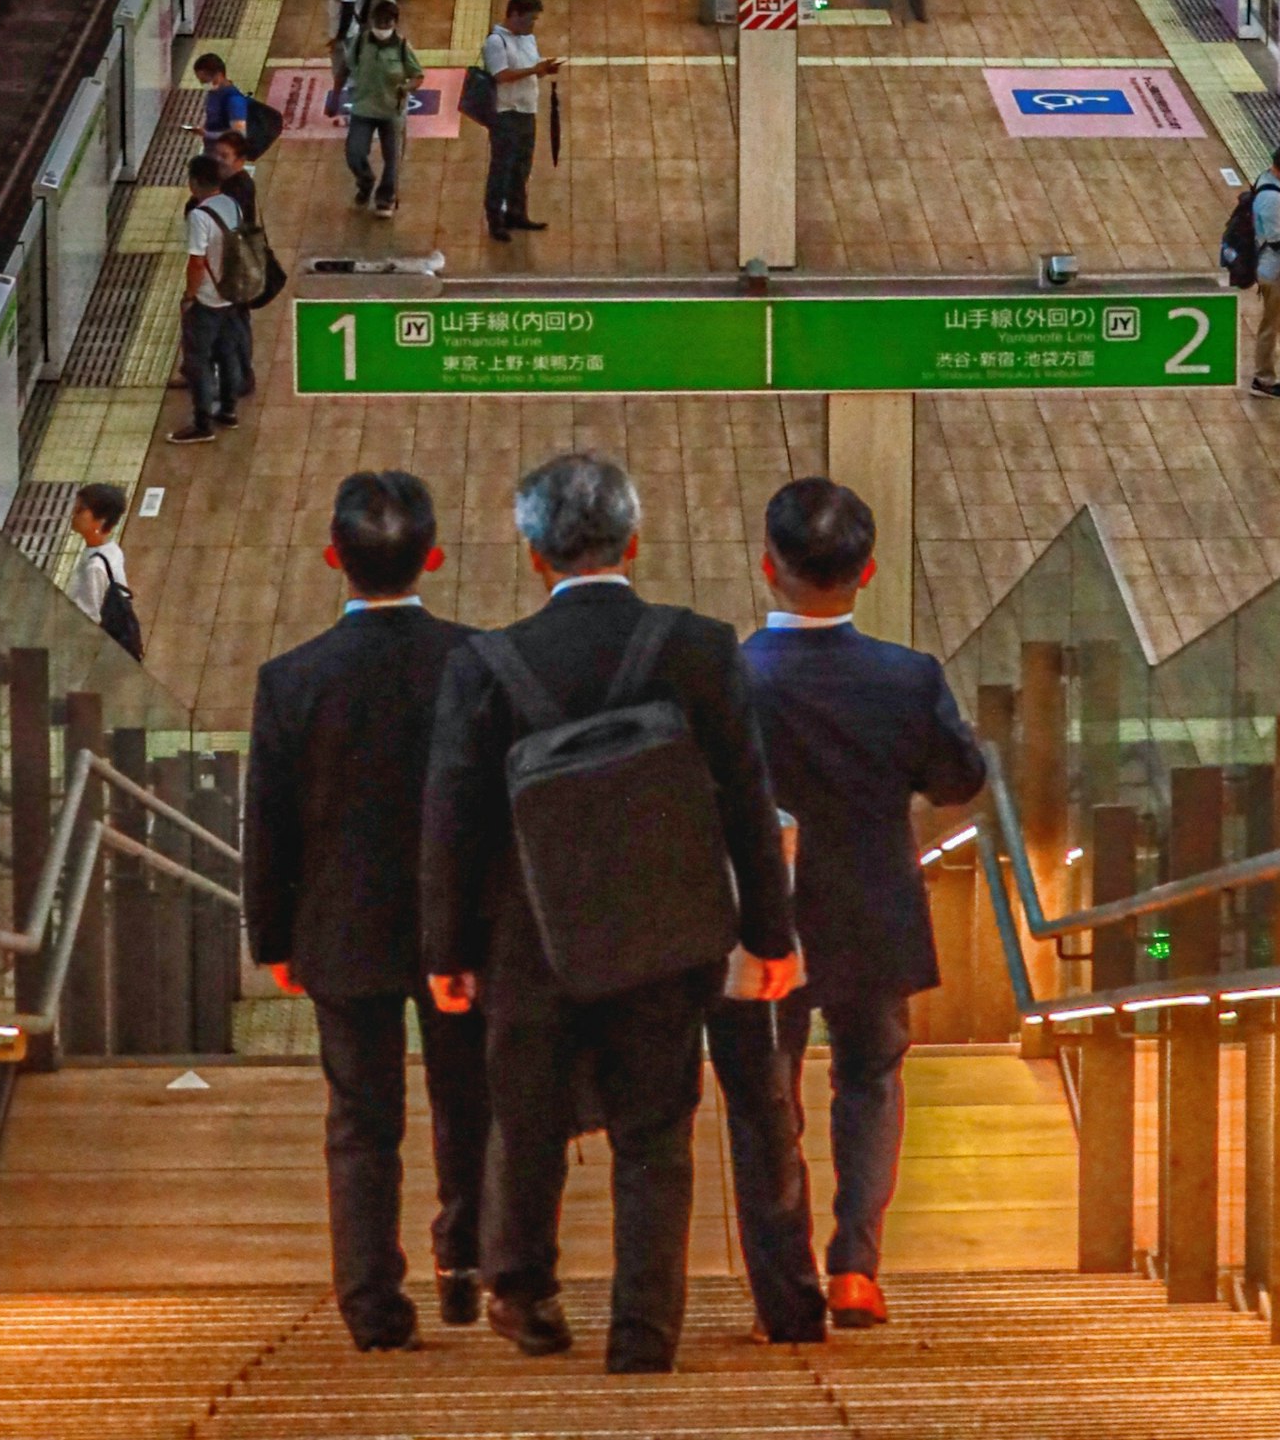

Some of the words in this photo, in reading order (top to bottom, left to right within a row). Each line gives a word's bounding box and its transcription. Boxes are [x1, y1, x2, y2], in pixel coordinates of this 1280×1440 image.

[441, 311, 594, 332] 山手線(内回り)
[945, 307, 1095, 329] 山手線(外回り)
[1111, 317, 1131, 331] JY
[405, 322, 425, 336] JY
[999, 332, 1063, 344] Yamanote
[1067, 331, 1095, 343] Line
[329, 314, 356, 380] 1
[443, 336, 509, 348] Yamanote
[514, 335, 543, 347] Line
[1165, 307, 1210, 374] 2
[442, 355, 604, 371] 東京・上野・巣鴨方面
[936, 350, 1095, 368] 渋谷・新宿・池袋方面
